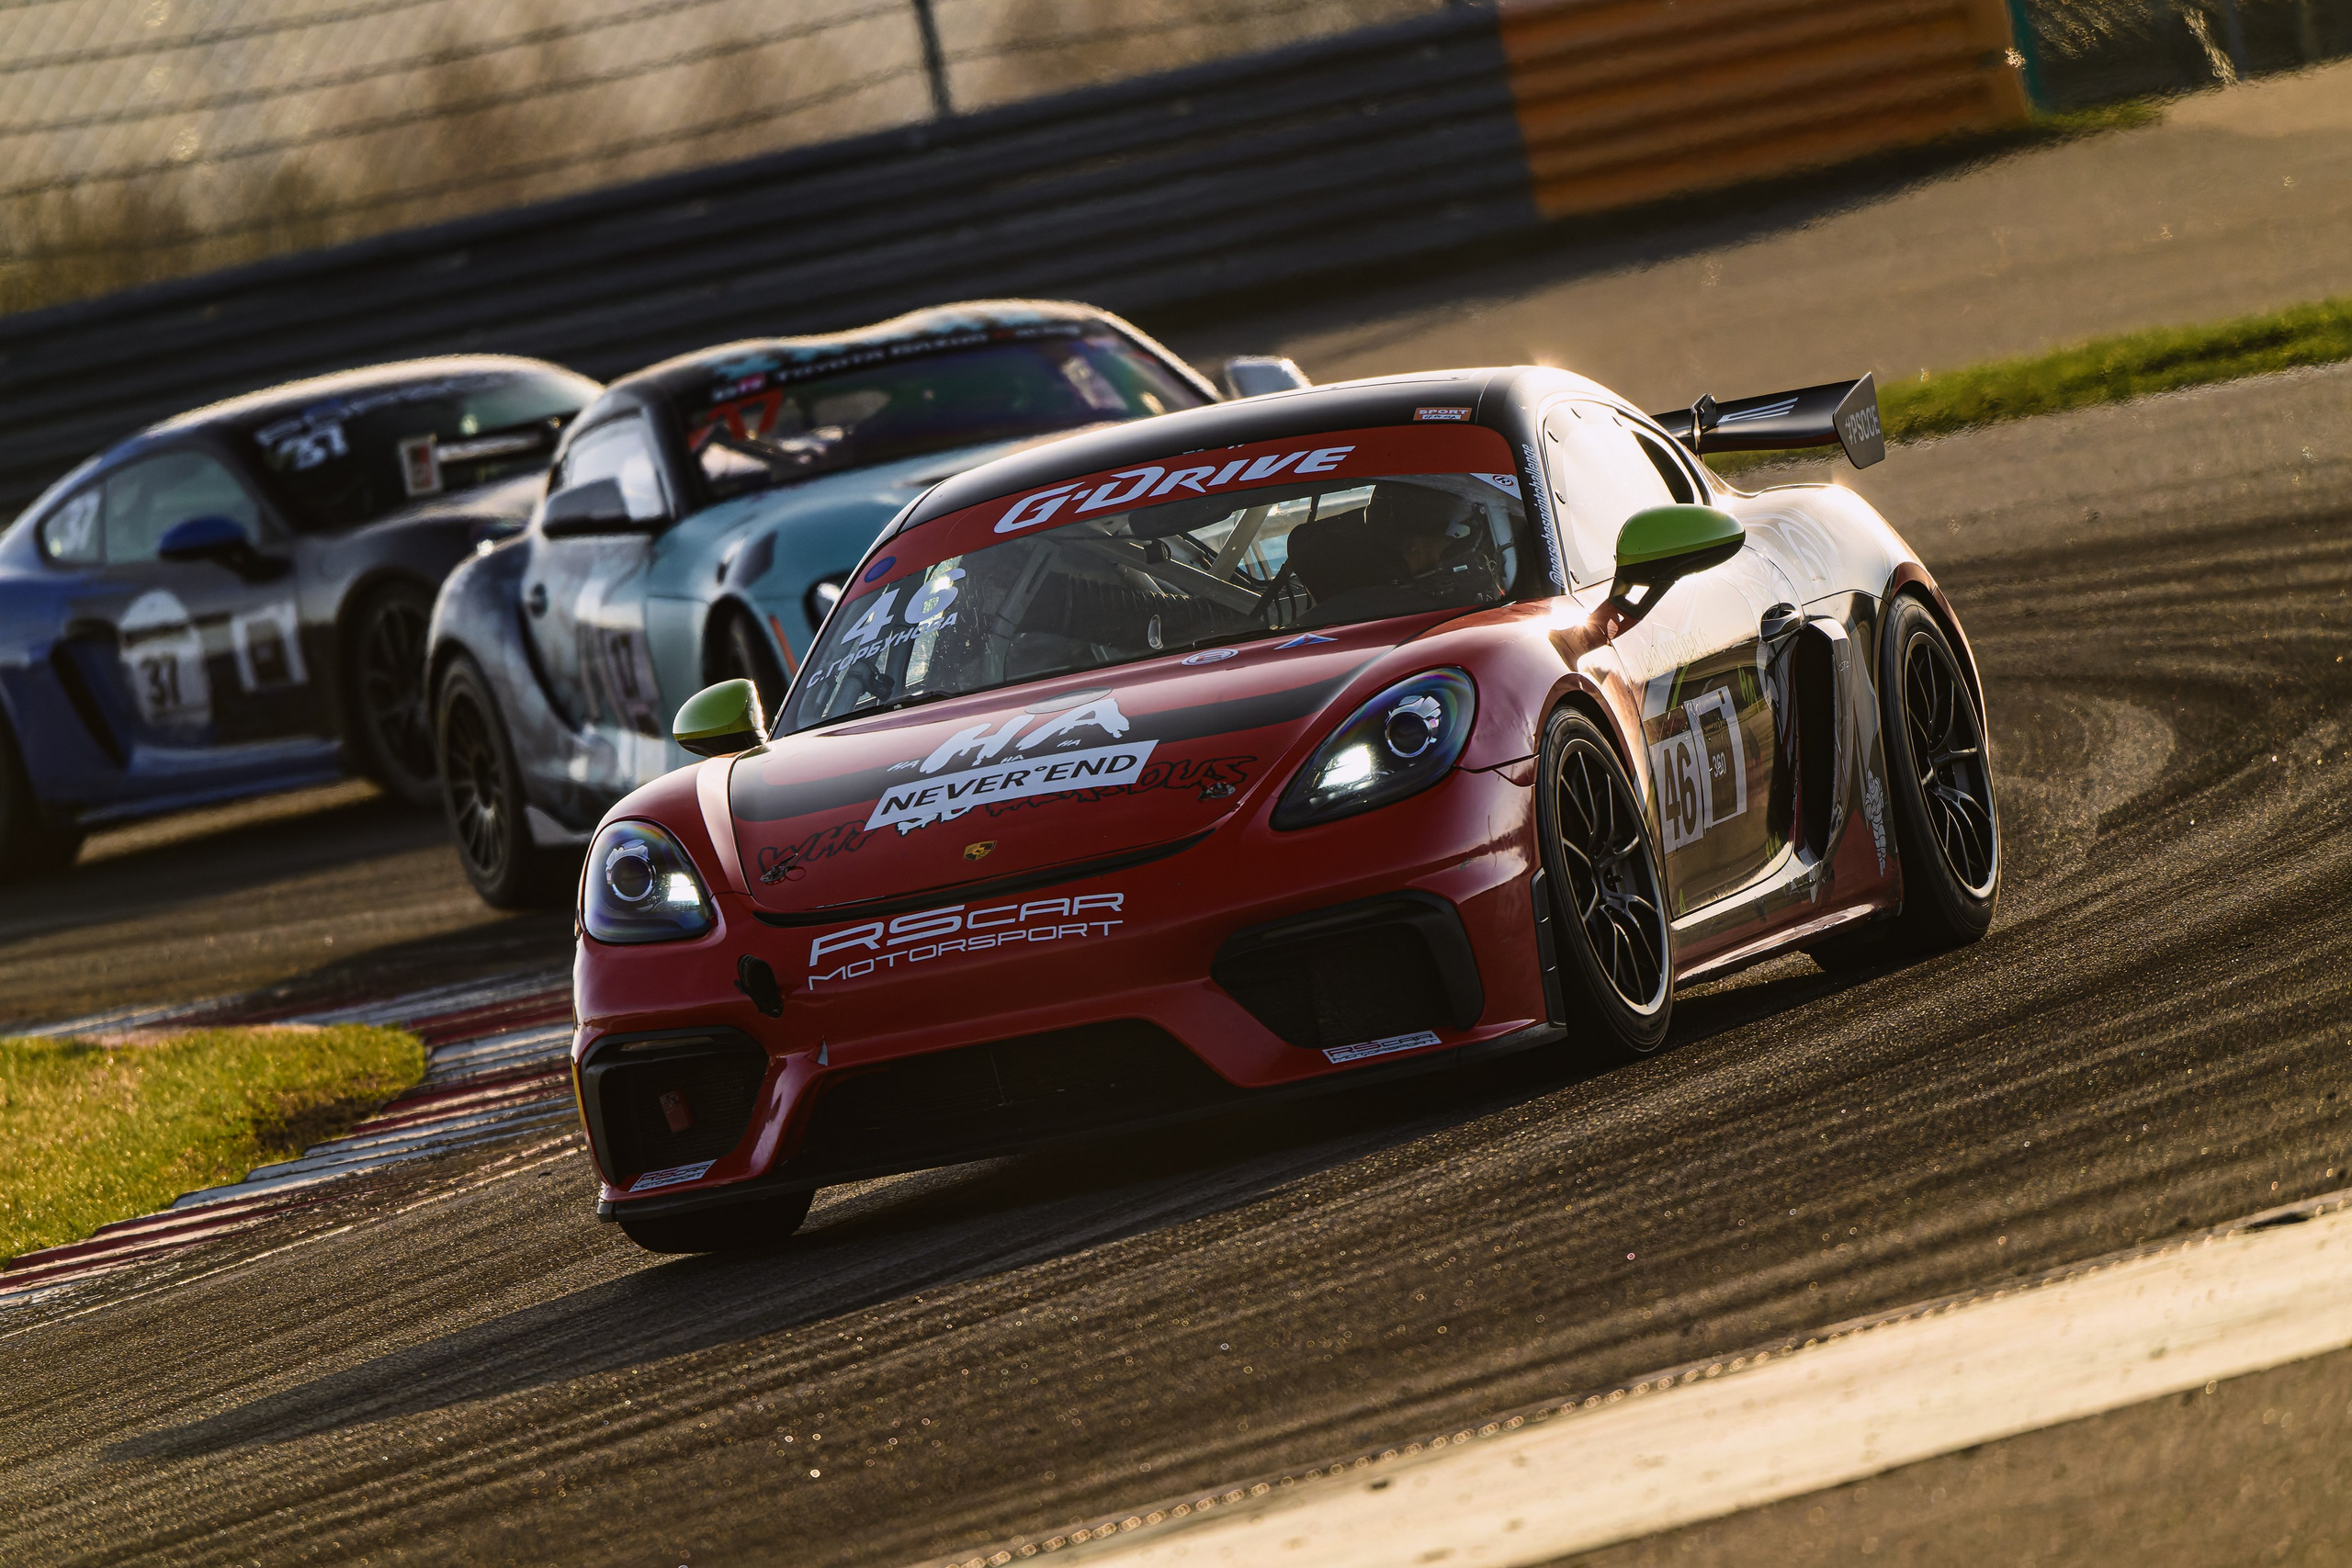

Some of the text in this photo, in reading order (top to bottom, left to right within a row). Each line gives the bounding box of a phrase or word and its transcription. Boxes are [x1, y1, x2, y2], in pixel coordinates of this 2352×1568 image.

[1521, 444, 1566, 589] @porschesprintchallenge
[841, 568, 966, 645] 46
[1663, 741, 1697, 841] 46
[808, 919, 1124, 991] MOTORSPORT
